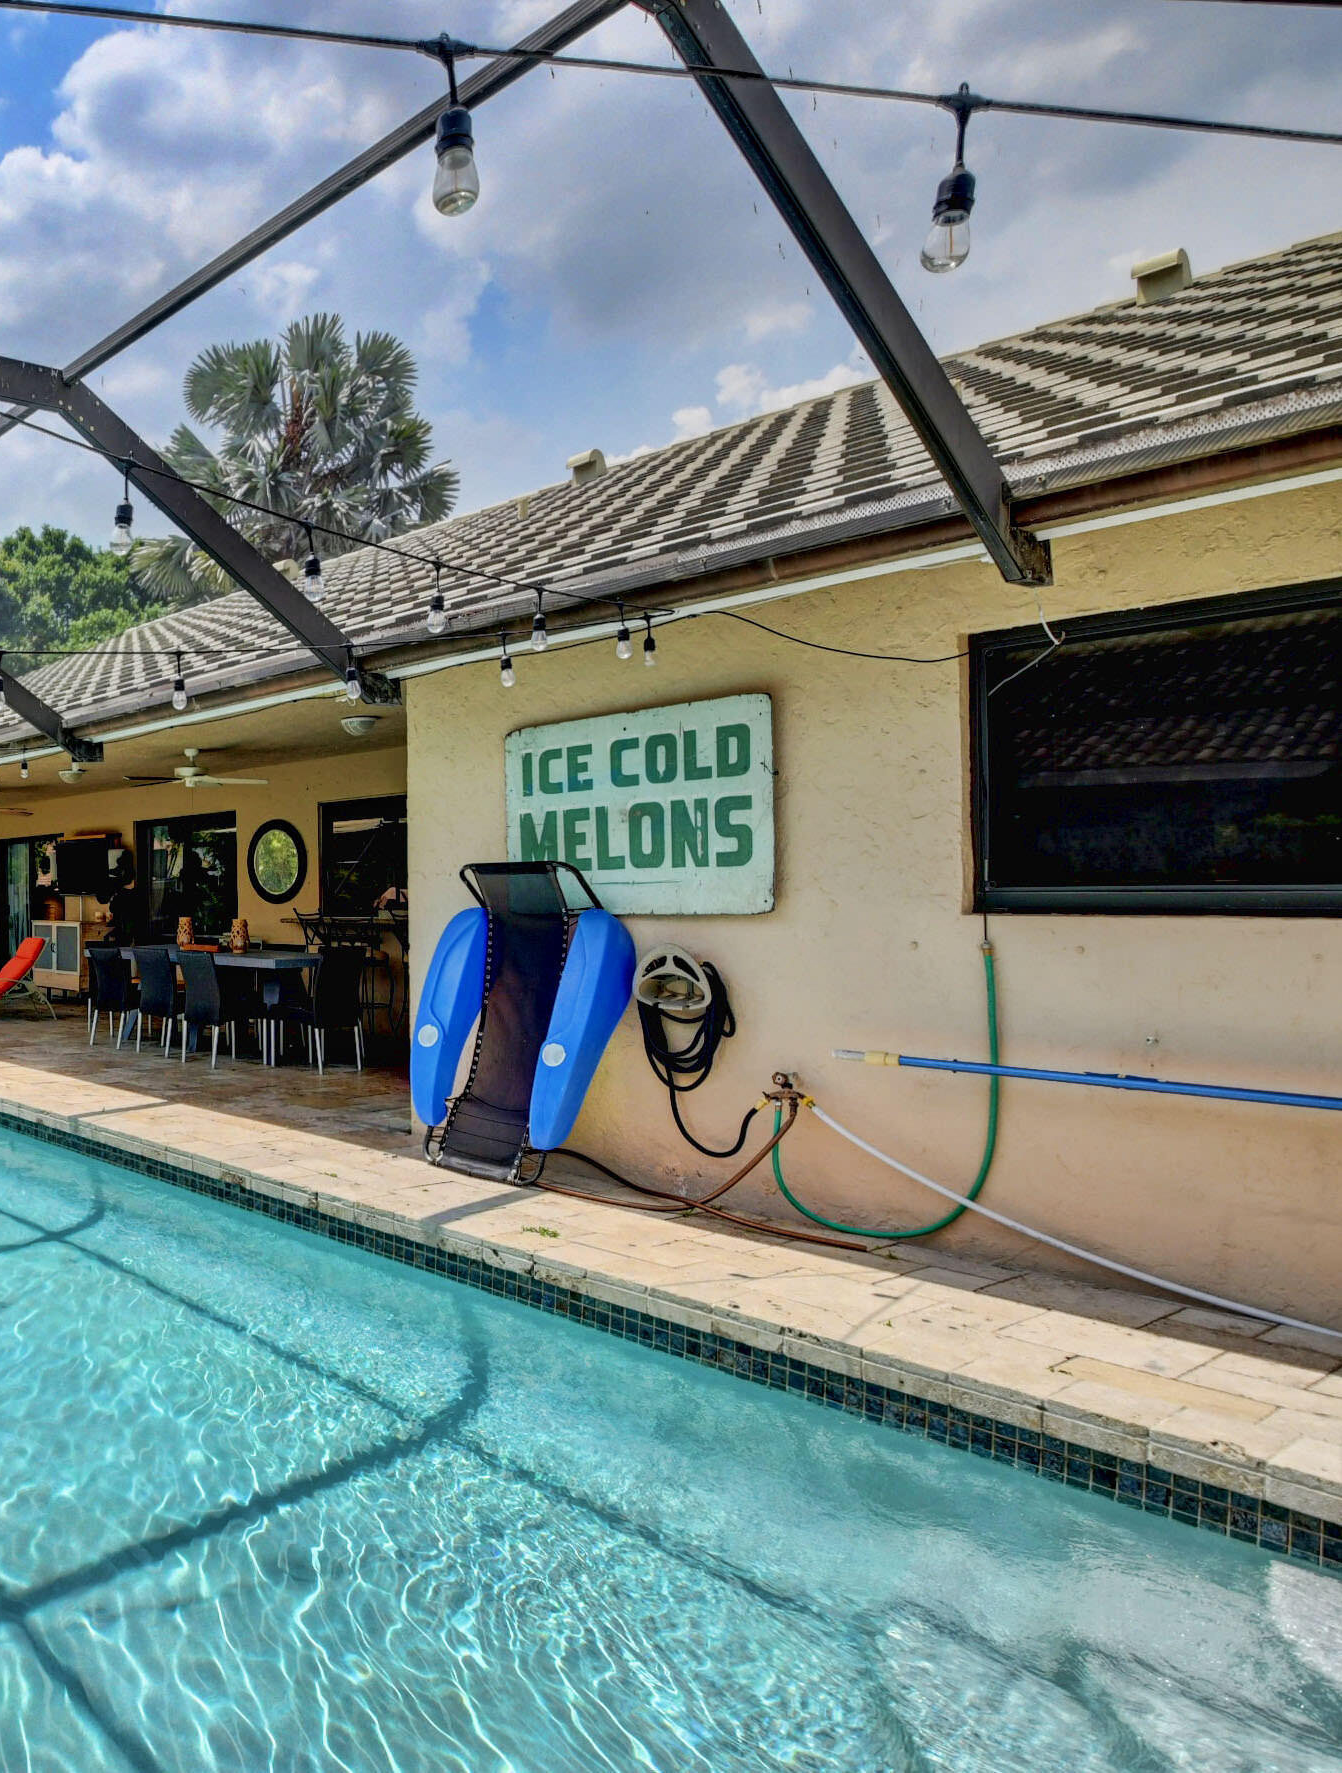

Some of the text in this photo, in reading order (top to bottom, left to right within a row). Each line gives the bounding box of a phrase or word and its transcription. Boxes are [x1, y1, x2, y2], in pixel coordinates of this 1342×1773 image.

[522, 723, 751, 797] ICE COLD
[519, 795, 753, 872] MELONS
